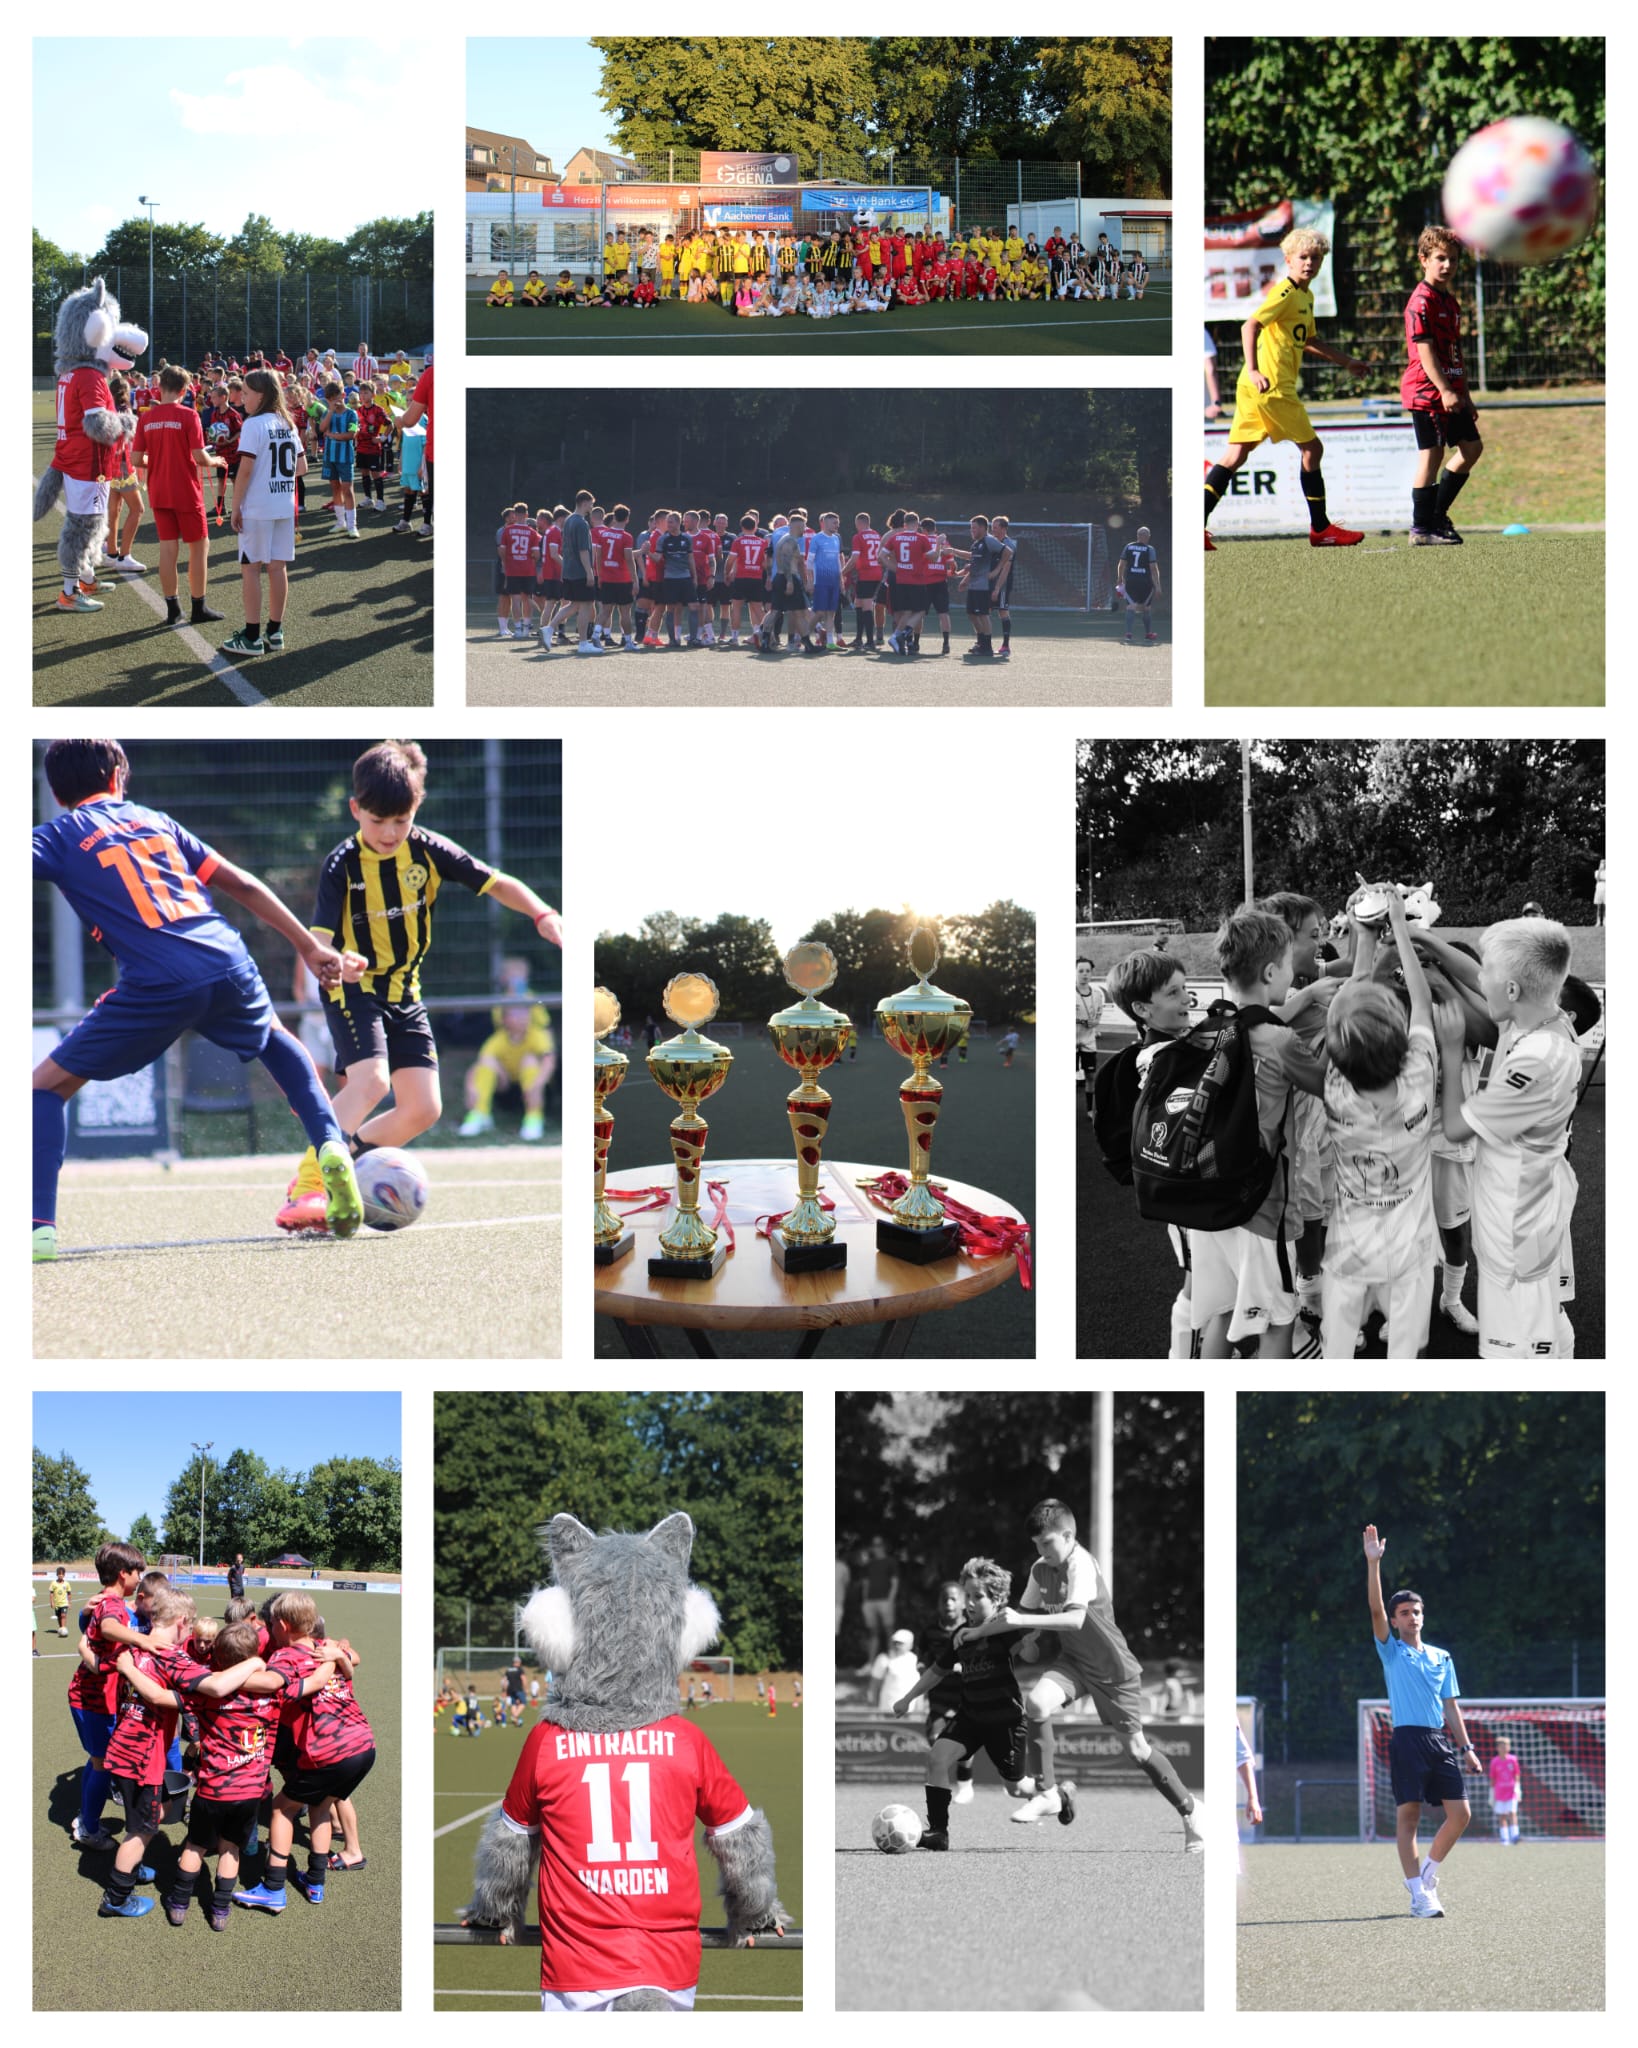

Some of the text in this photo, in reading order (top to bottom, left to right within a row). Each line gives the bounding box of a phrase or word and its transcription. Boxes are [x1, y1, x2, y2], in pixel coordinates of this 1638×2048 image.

[736, 164, 772, 172] ELEKTRO
[736, 172, 774, 185] GENA
[574, 196, 668, 205] Herzlih willkommen
[852, 196, 897, 206] VR-Bank
[724, 211, 789, 221] Aachener Bank
[268, 441, 296, 478] 10
[1229, 470, 1277, 496] ER
[511, 535, 530, 555] 29
[607, 538, 615, 560] 7
[745, 545, 761, 565] 17
[900, 542, 911, 563] 6
[1132, 551, 1141, 568] 7
[96, 834, 212, 929] 10
[555, 1730, 676, 1760] EINTRACHT
[581, 1762, 659, 1863] 11
[578, 1867, 669, 1896] WARDEN
